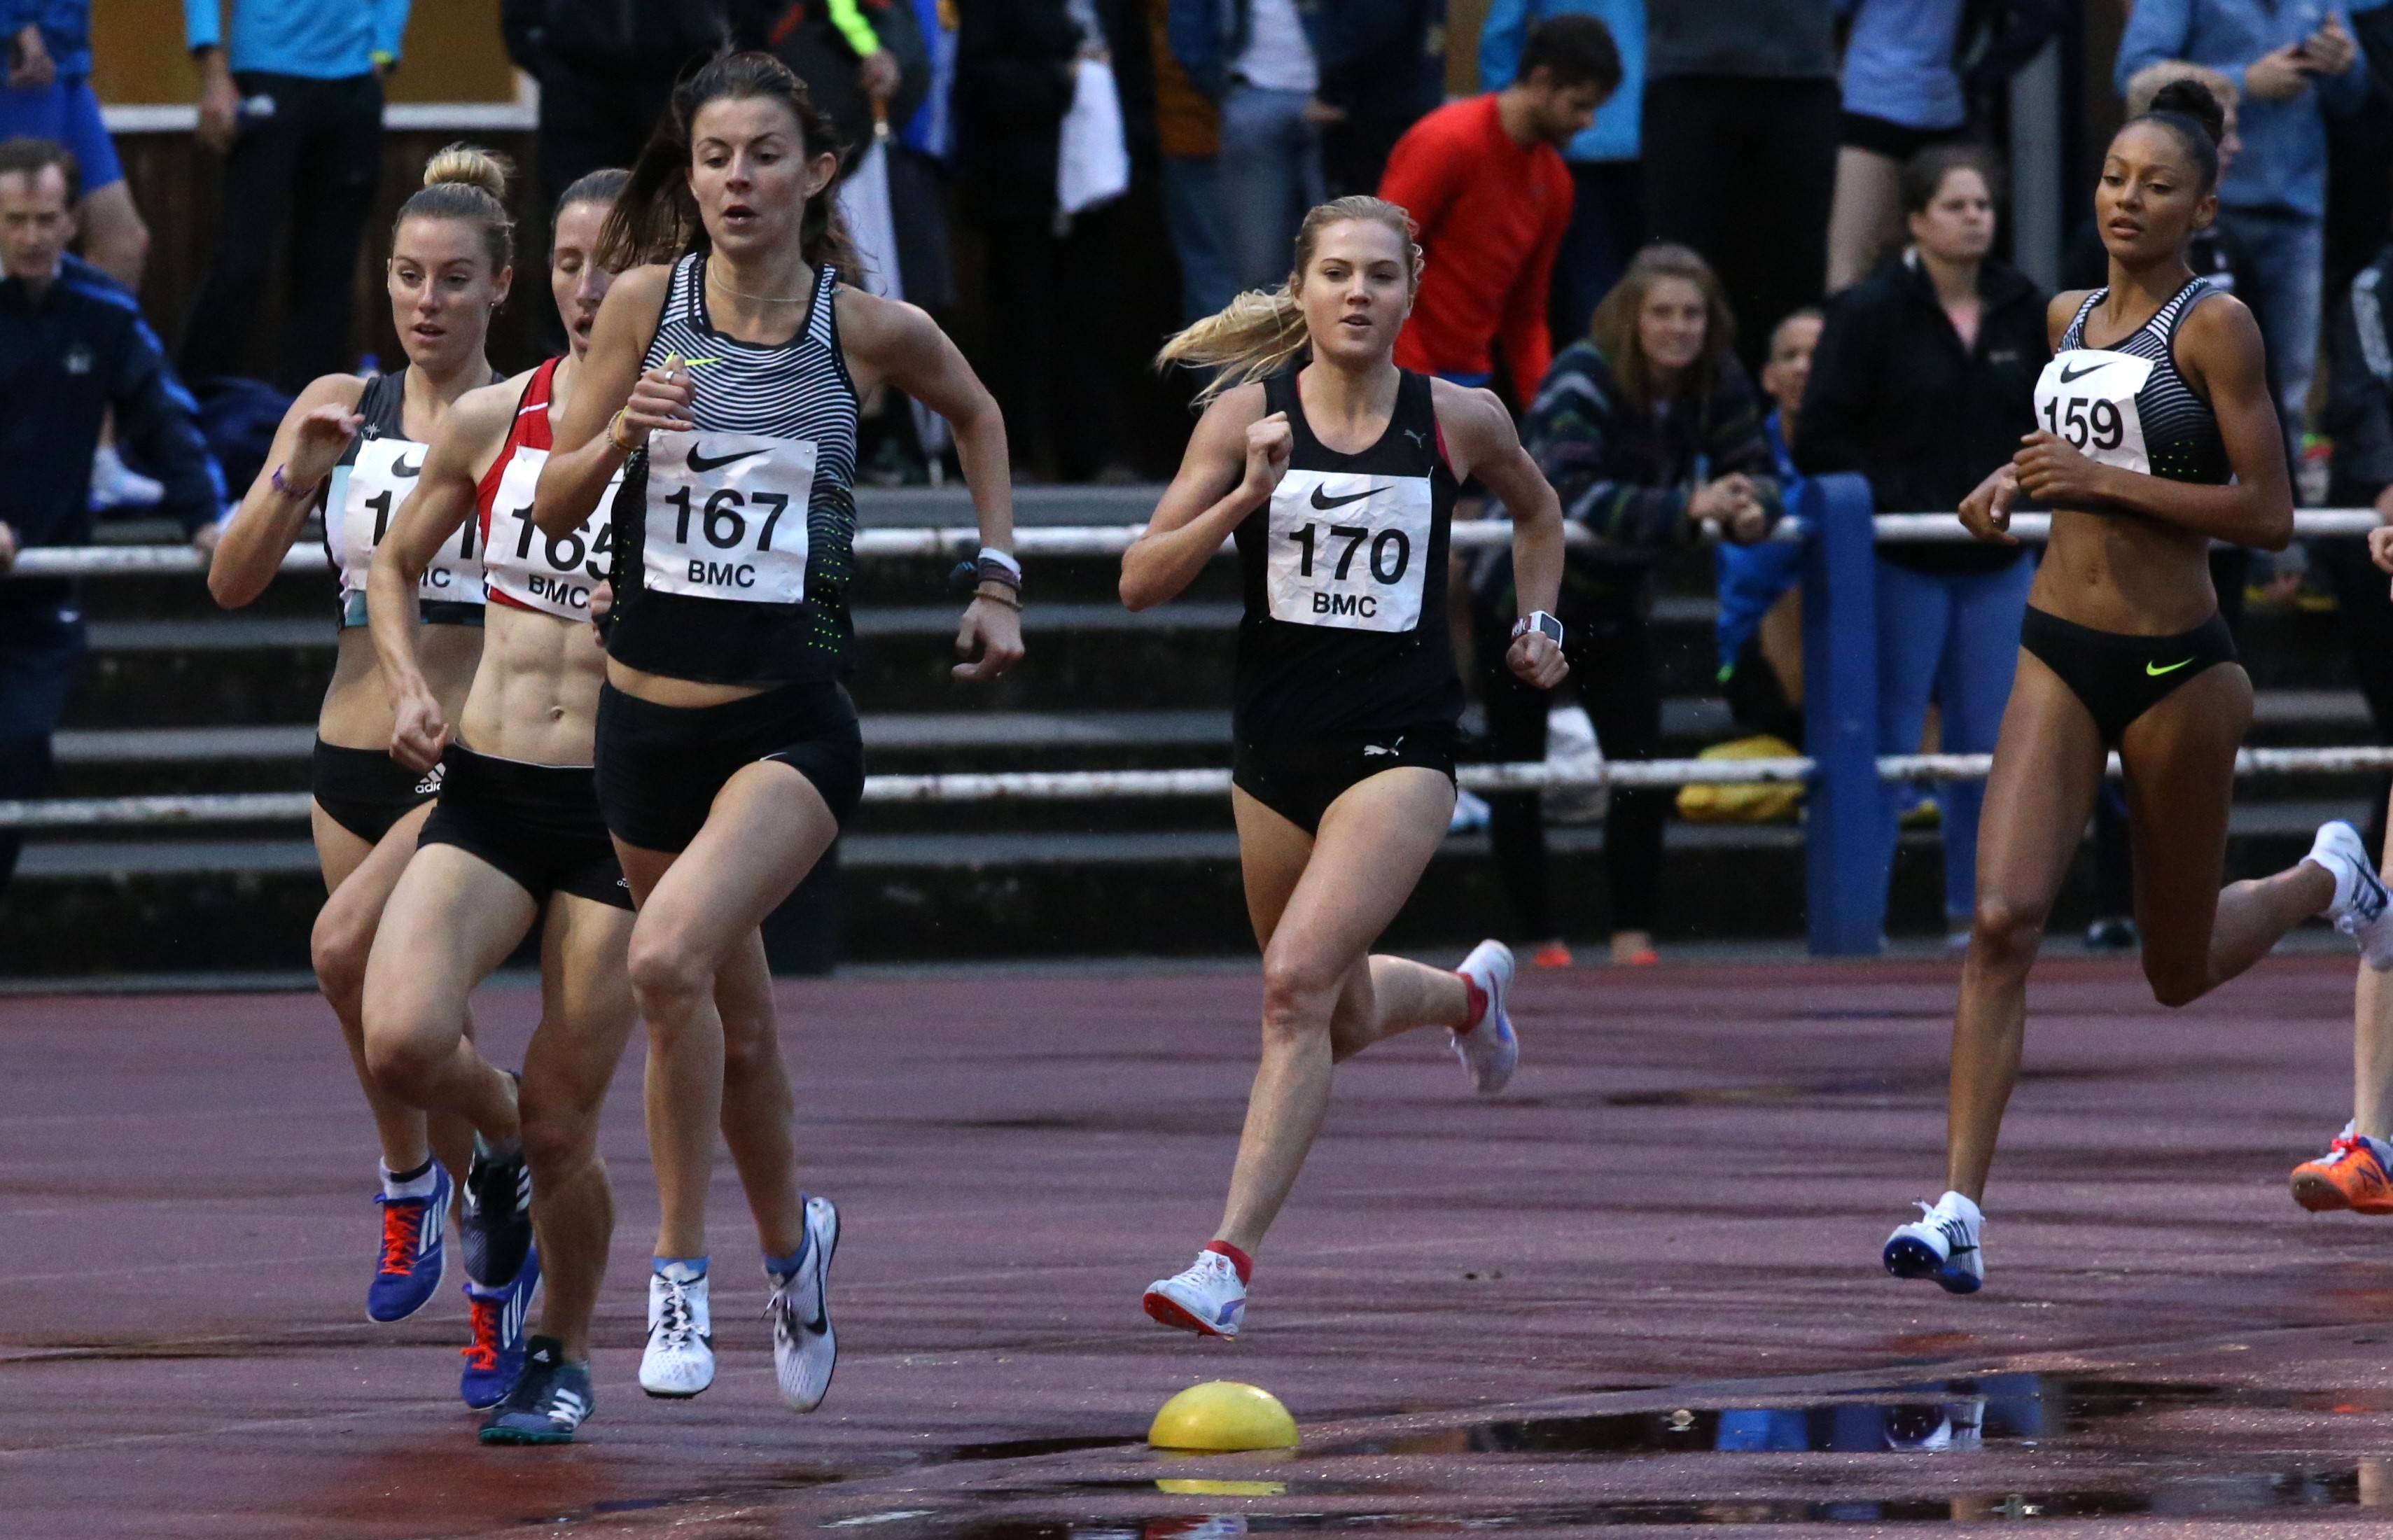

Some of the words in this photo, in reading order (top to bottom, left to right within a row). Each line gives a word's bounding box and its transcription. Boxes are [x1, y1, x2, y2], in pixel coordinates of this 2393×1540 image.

[2044, 396, 2123, 450] 159
[365, 490, 479, 559] 11
[665, 485, 789, 552] 167
[688, 559, 755, 588] BMC
[1289, 522, 1410, 585] 170
[528, 573, 590, 609] BMC
[1312, 592, 1377, 618] BMC
